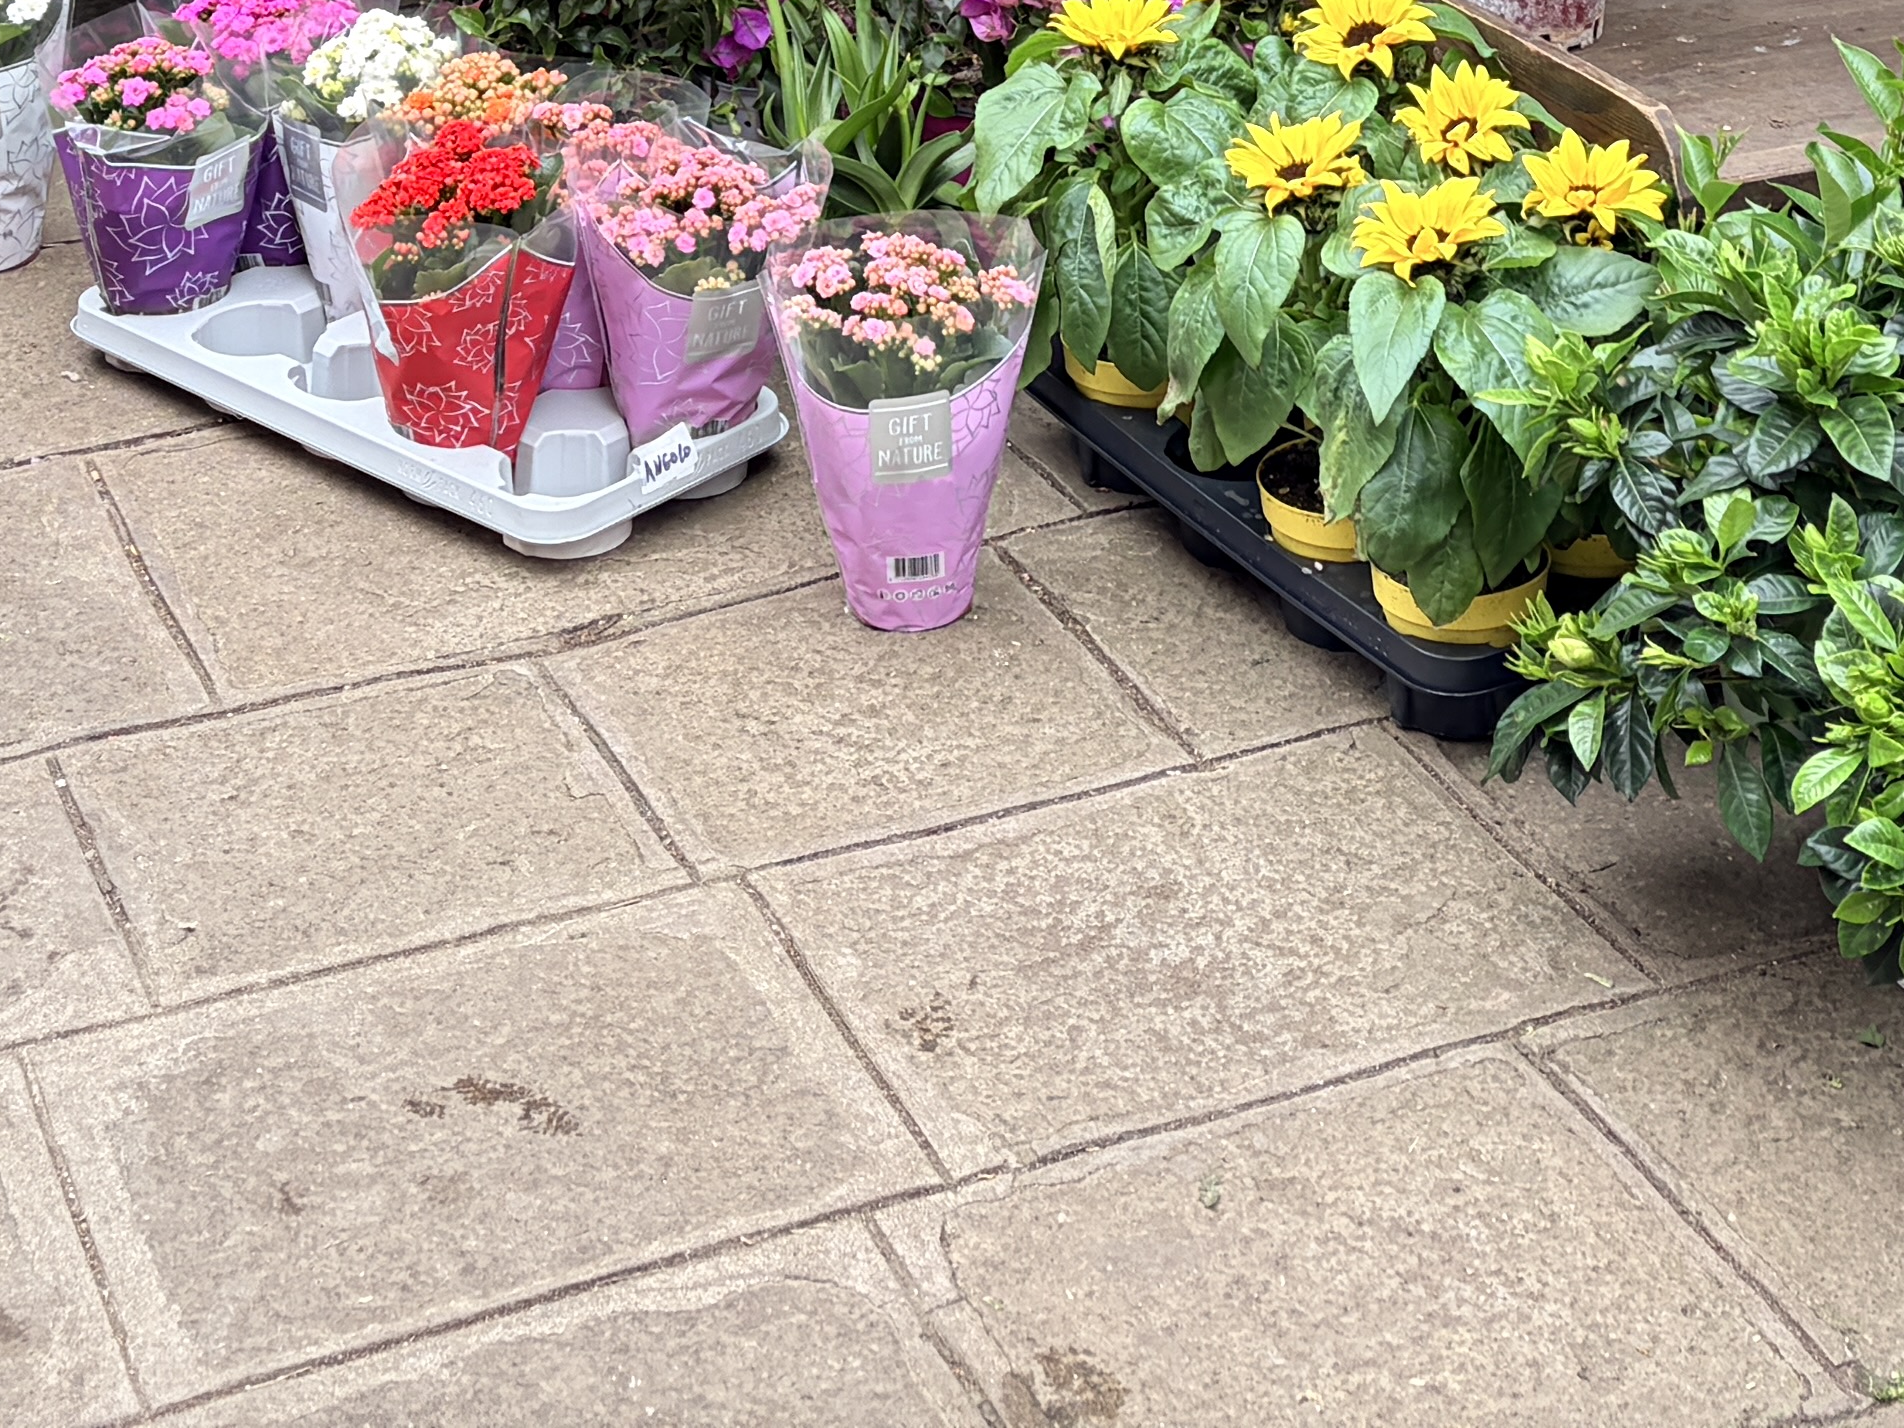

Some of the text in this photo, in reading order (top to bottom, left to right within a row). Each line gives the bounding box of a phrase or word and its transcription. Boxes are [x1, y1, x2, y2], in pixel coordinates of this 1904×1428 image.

[203, 154, 237, 183] GIFT
[192, 183, 240, 214] NATURE
[707, 298, 749, 322] GIFT
[888, 412, 933, 437] GIFT
[878, 441, 943, 468] NATURE
